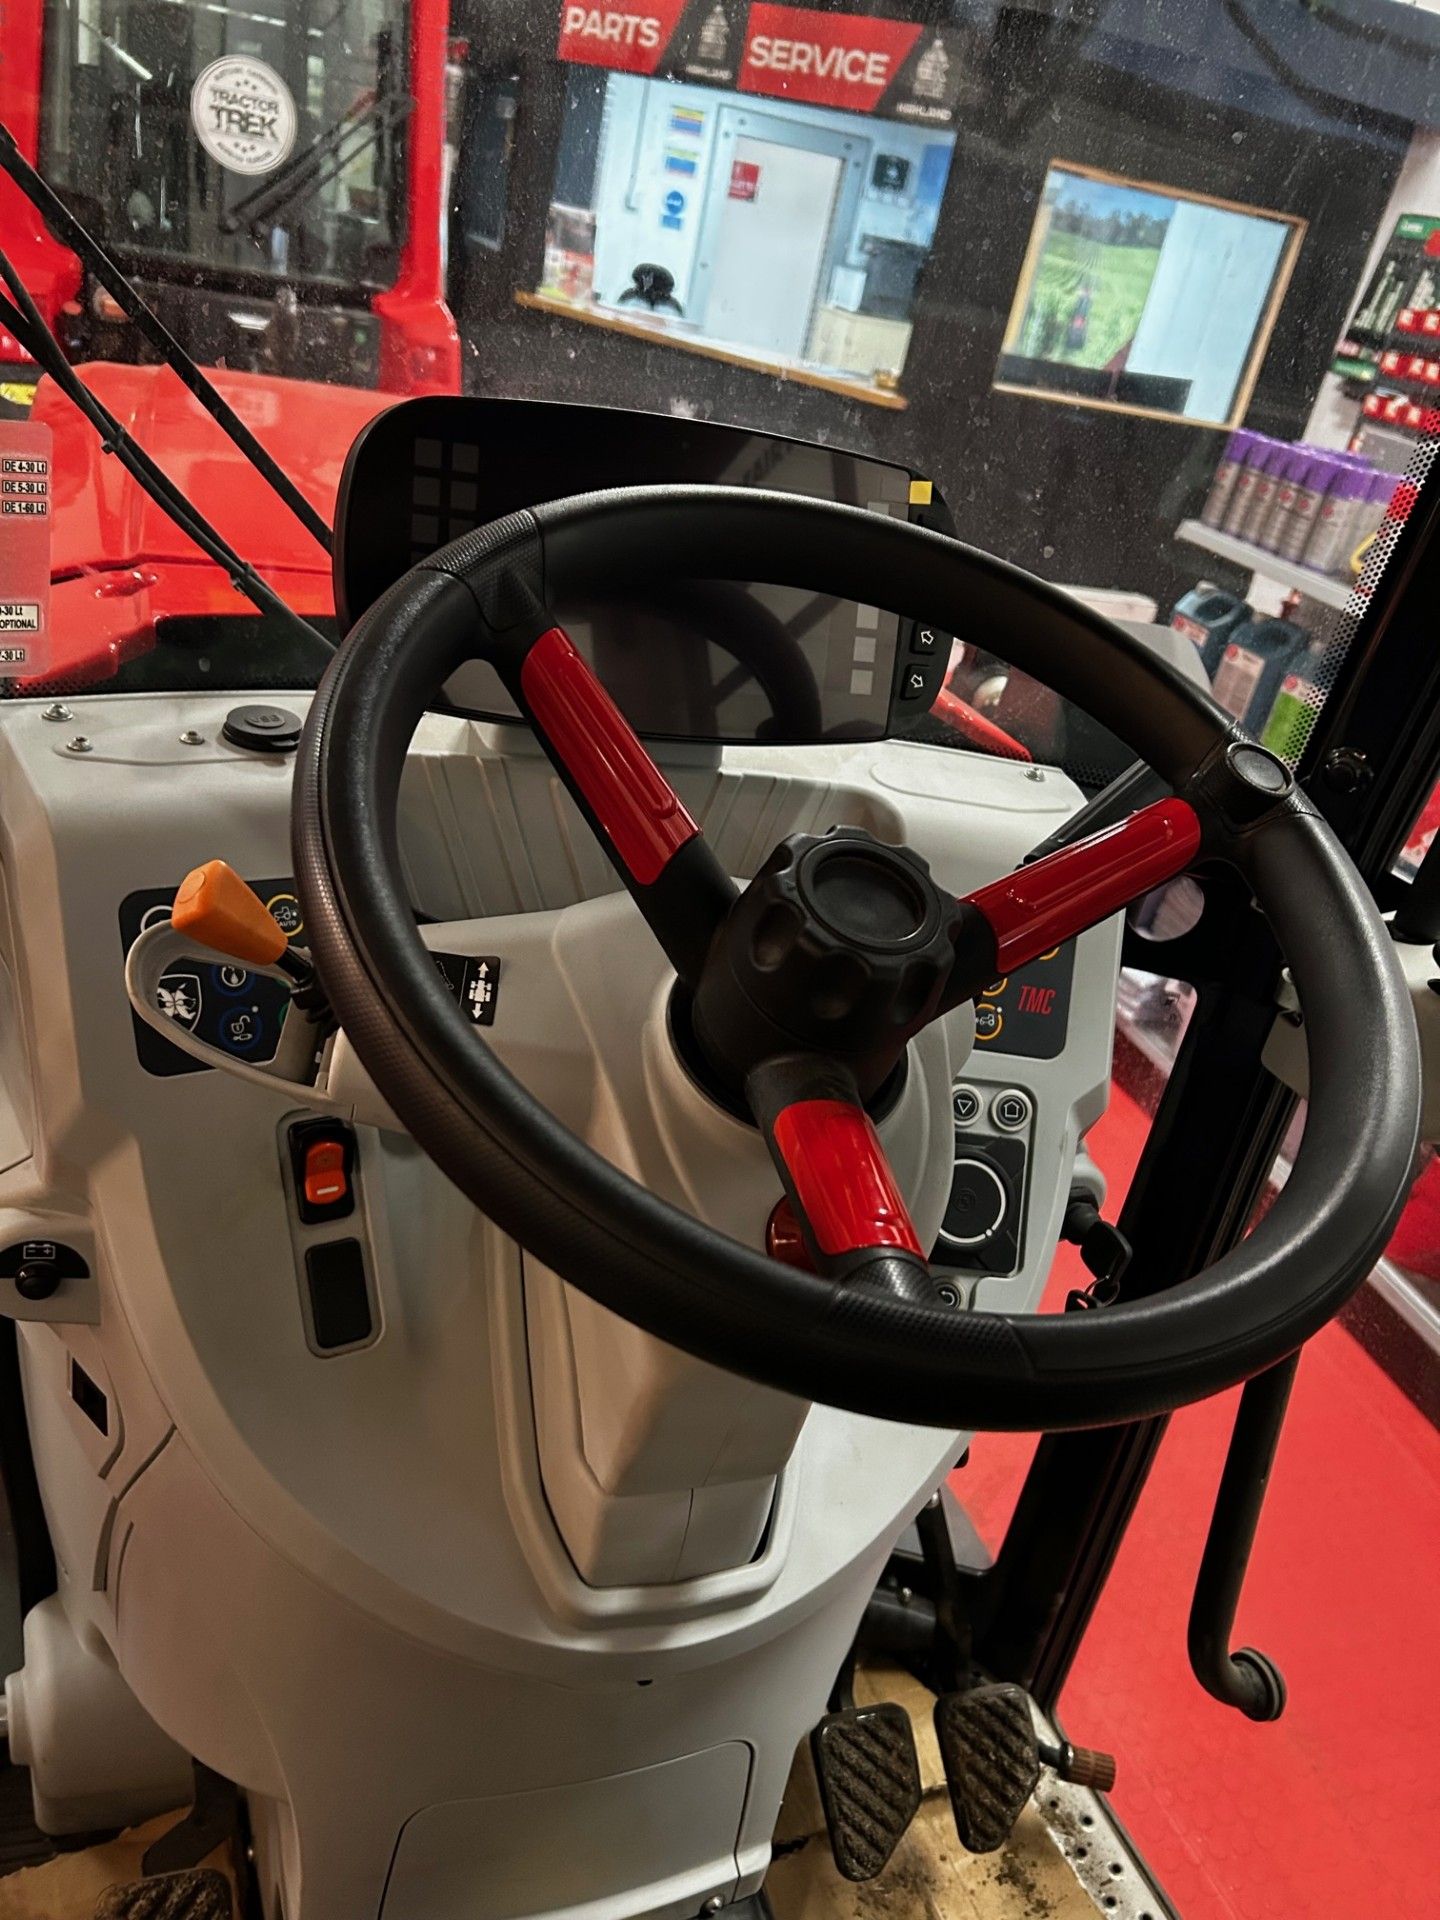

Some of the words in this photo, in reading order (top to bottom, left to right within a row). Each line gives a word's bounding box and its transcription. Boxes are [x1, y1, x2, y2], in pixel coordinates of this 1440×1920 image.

[562, 6, 661, 48] PARTS
[747, 35, 891, 86] SERVICE
[209, 85, 280, 115] TRACTOR
[208, 104, 280, 142] TREK
[4, 460, 17, 472] DE
[18, 460, 35, 473] 4-30
[36, 461, 45, 473] Lt
[4, 481, 17, 492] DE
[18, 481, 35, 493] 5-30
[36, 482, 45, 494] Lt
[4, 502, 17, 513] DE
[18, 502, 35, 513] 1-60
[36, 503, 45, 514] Lt
[0, 618, 36, 629] OPTIONAL
[0, 650, 13, 661] -30
[1018, 984, 1057, 1015] TMC
